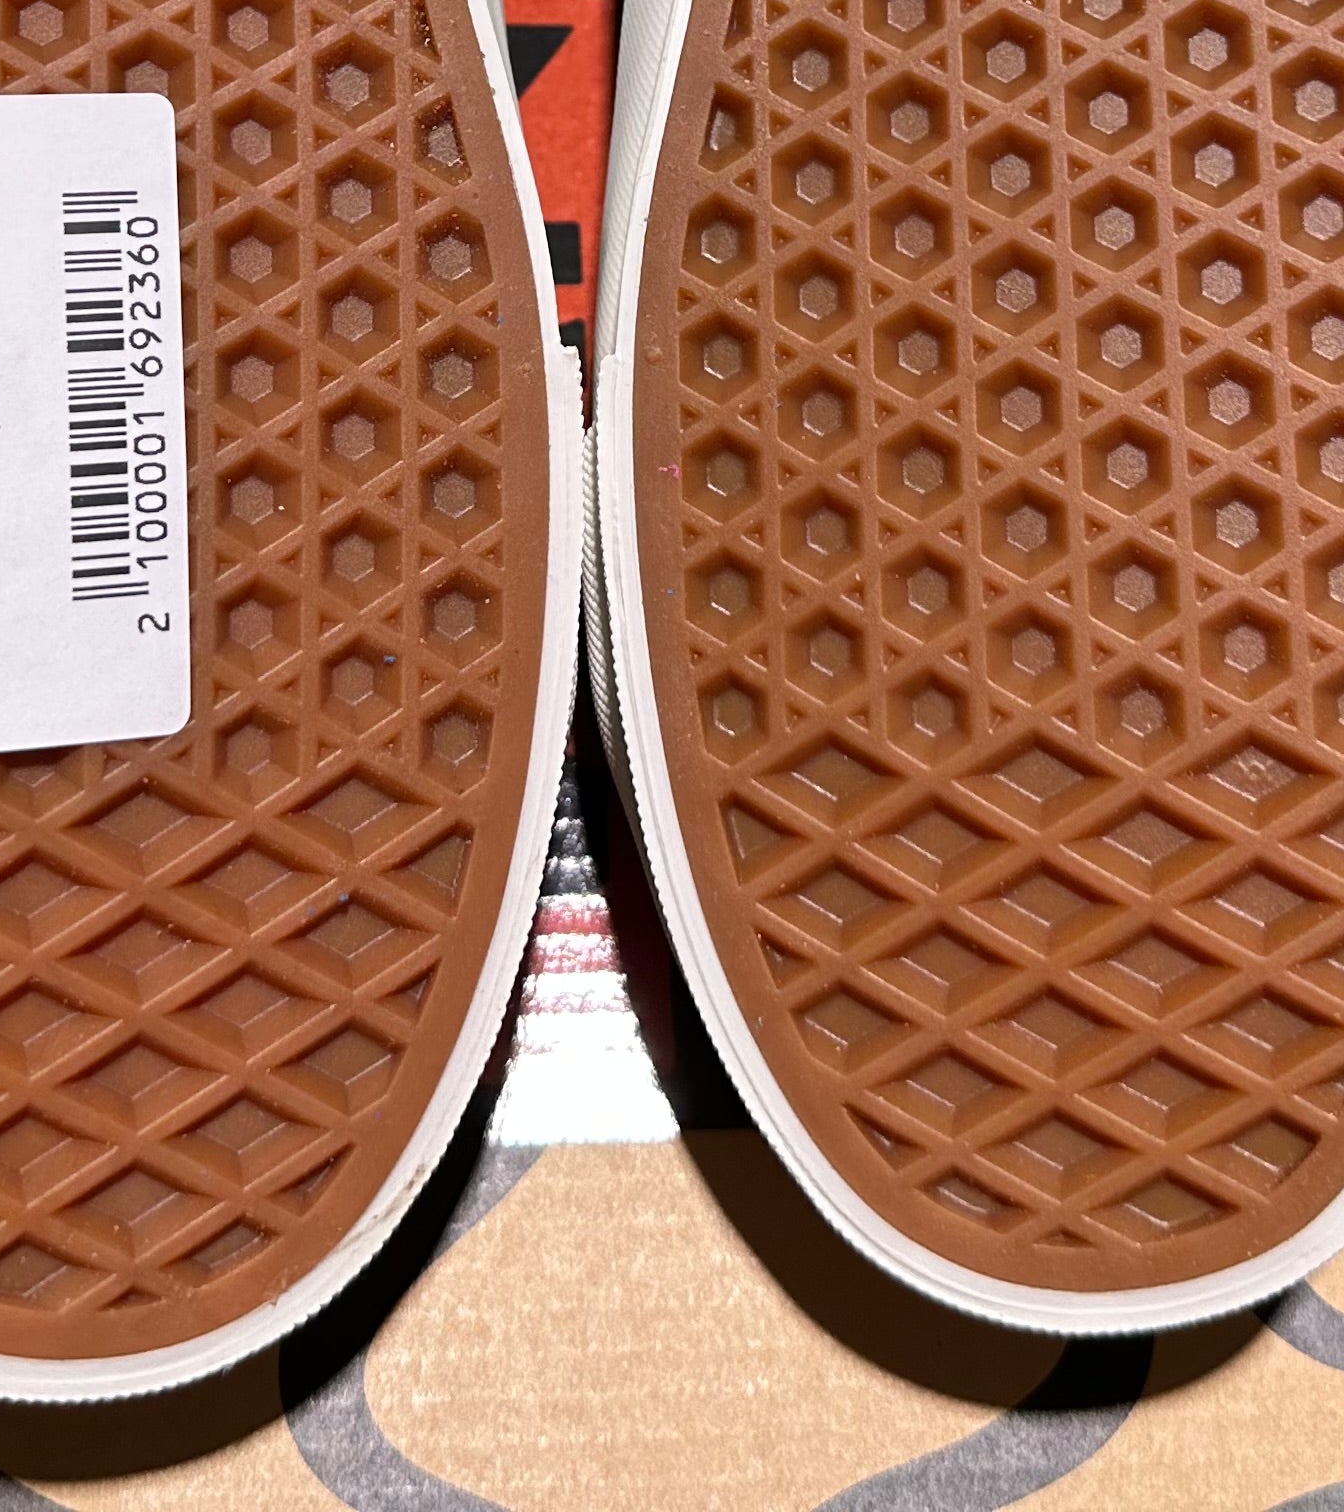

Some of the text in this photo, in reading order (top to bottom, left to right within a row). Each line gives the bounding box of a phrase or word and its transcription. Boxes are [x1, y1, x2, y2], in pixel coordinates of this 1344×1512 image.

[125, 215, 170, 634] 2 100001 692360
